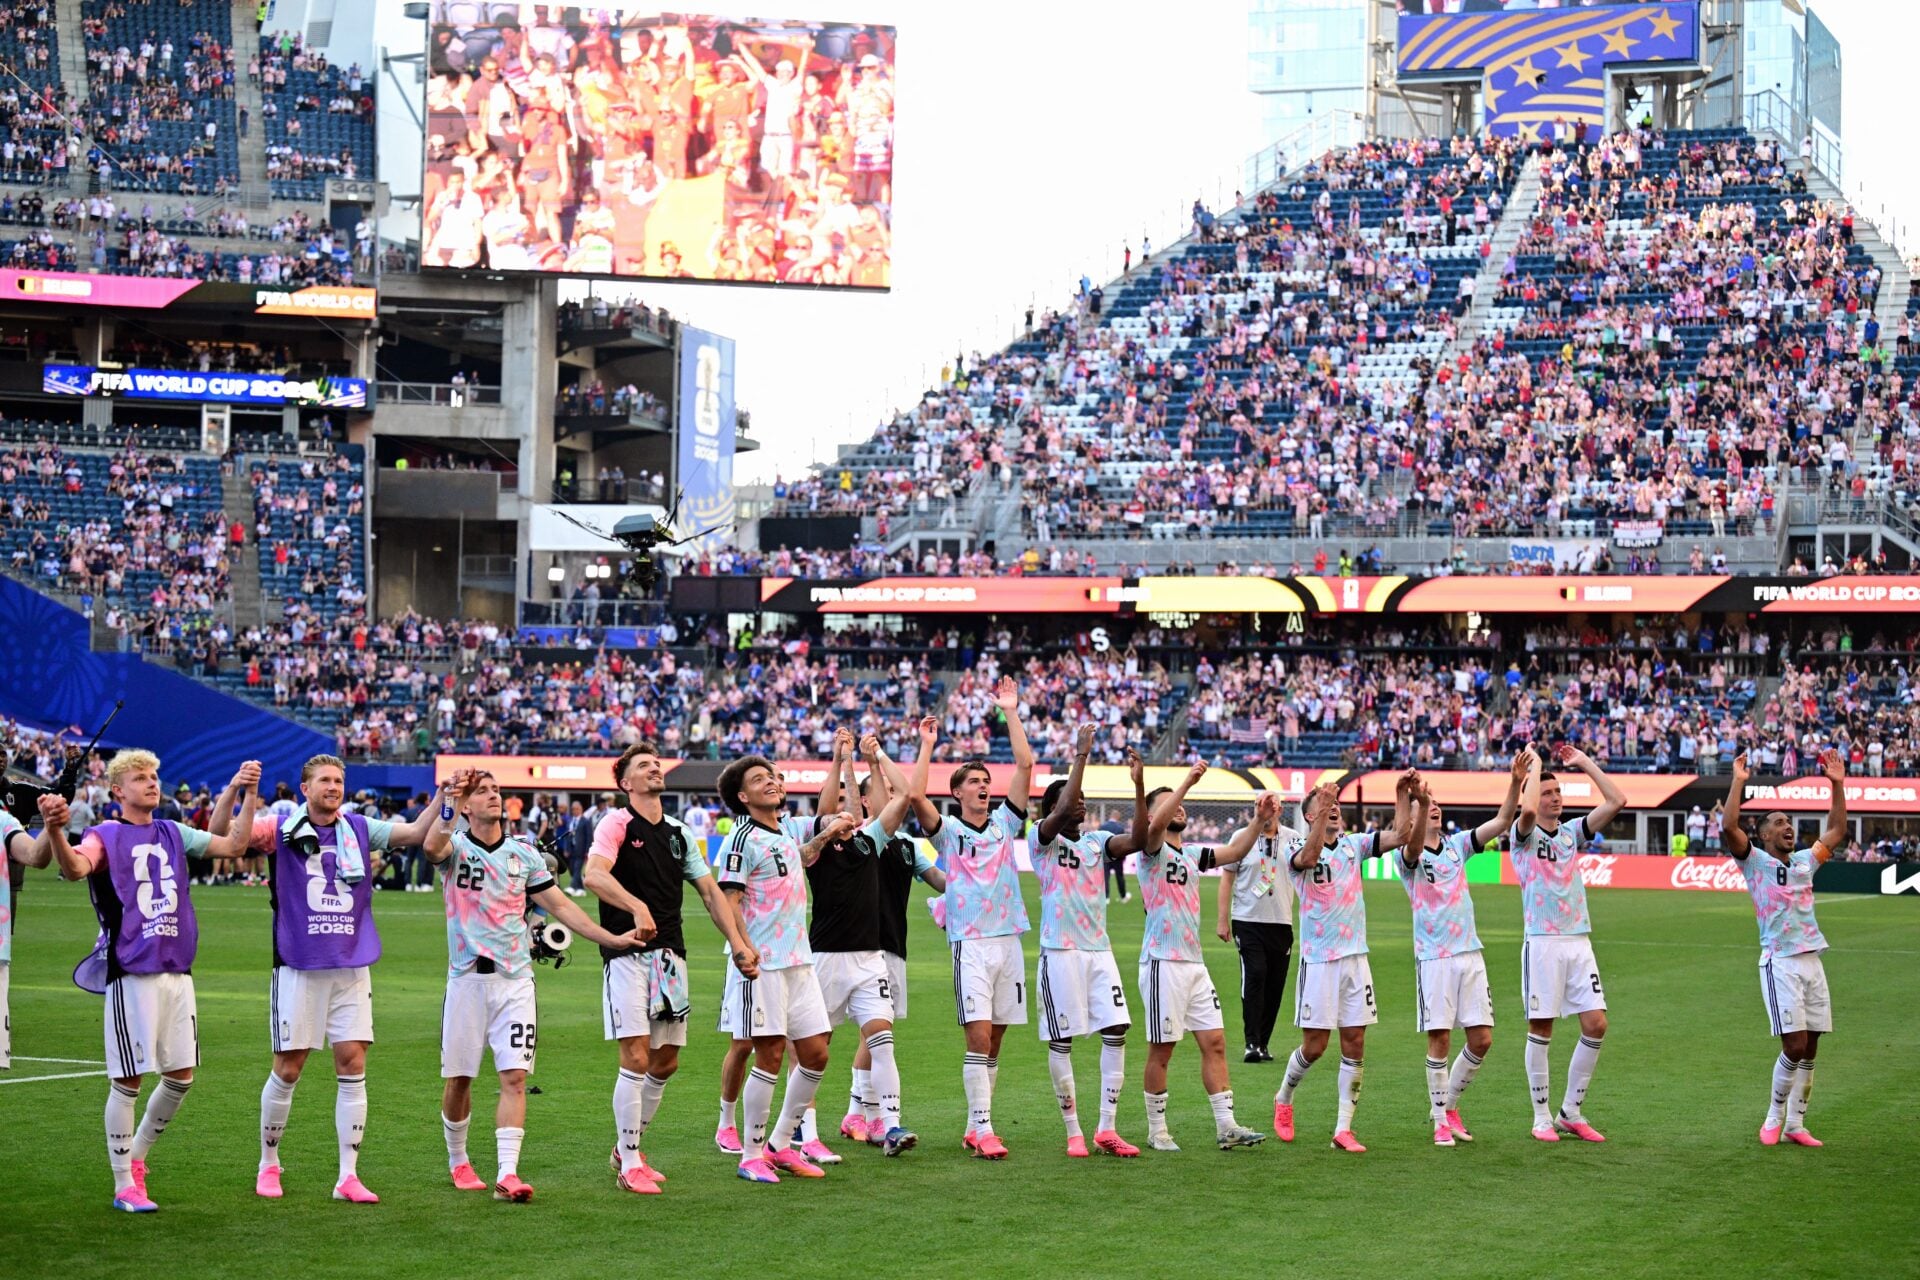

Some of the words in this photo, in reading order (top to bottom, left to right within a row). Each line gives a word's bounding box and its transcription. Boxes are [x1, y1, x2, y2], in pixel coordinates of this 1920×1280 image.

[332, 182, 375, 195] 344
[256, 291, 291, 306] FIFA
[292, 293, 351, 309] WORLD
[91, 373, 134, 391] FIFA
[136, 375, 206, 394] WORLD
[209, 377, 249, 395] CUP
[1753, 586, 1789, 600] FIFA
[1790, 586, 1851, 600] WORLD
[1853, 586, 1887, 600] CUP
[1744, 785, 1776, 799] FIFA
[1776, 786, 1831, 800] WORLD
[1843, 787, 1863, 800] UP
[773, 853, 788, 877] 6
[1057, 845, 1080, 870] 25
[457, 863, 485, 892] 22
[1166, 862, 1188, 886] 23
[1313, 862, 1331, 884] 21
[1423, 864, 1435, 884] 5
[1776, 866, 1787, 886] 8
[151, 899, 171, 911] FIFA
[321, 897, 342, 907] FIFA
[142, 916, 168, 930] WORLD
[168, 916, 178, 925] CUP
[307, 914, 338, 923] WORLD
[339, 915, 355, 924] CUP
[142, 924, 178, 939] 2026
[307, 922, 355, 935] 2026
[510, 1023, 535, 1050] 22
